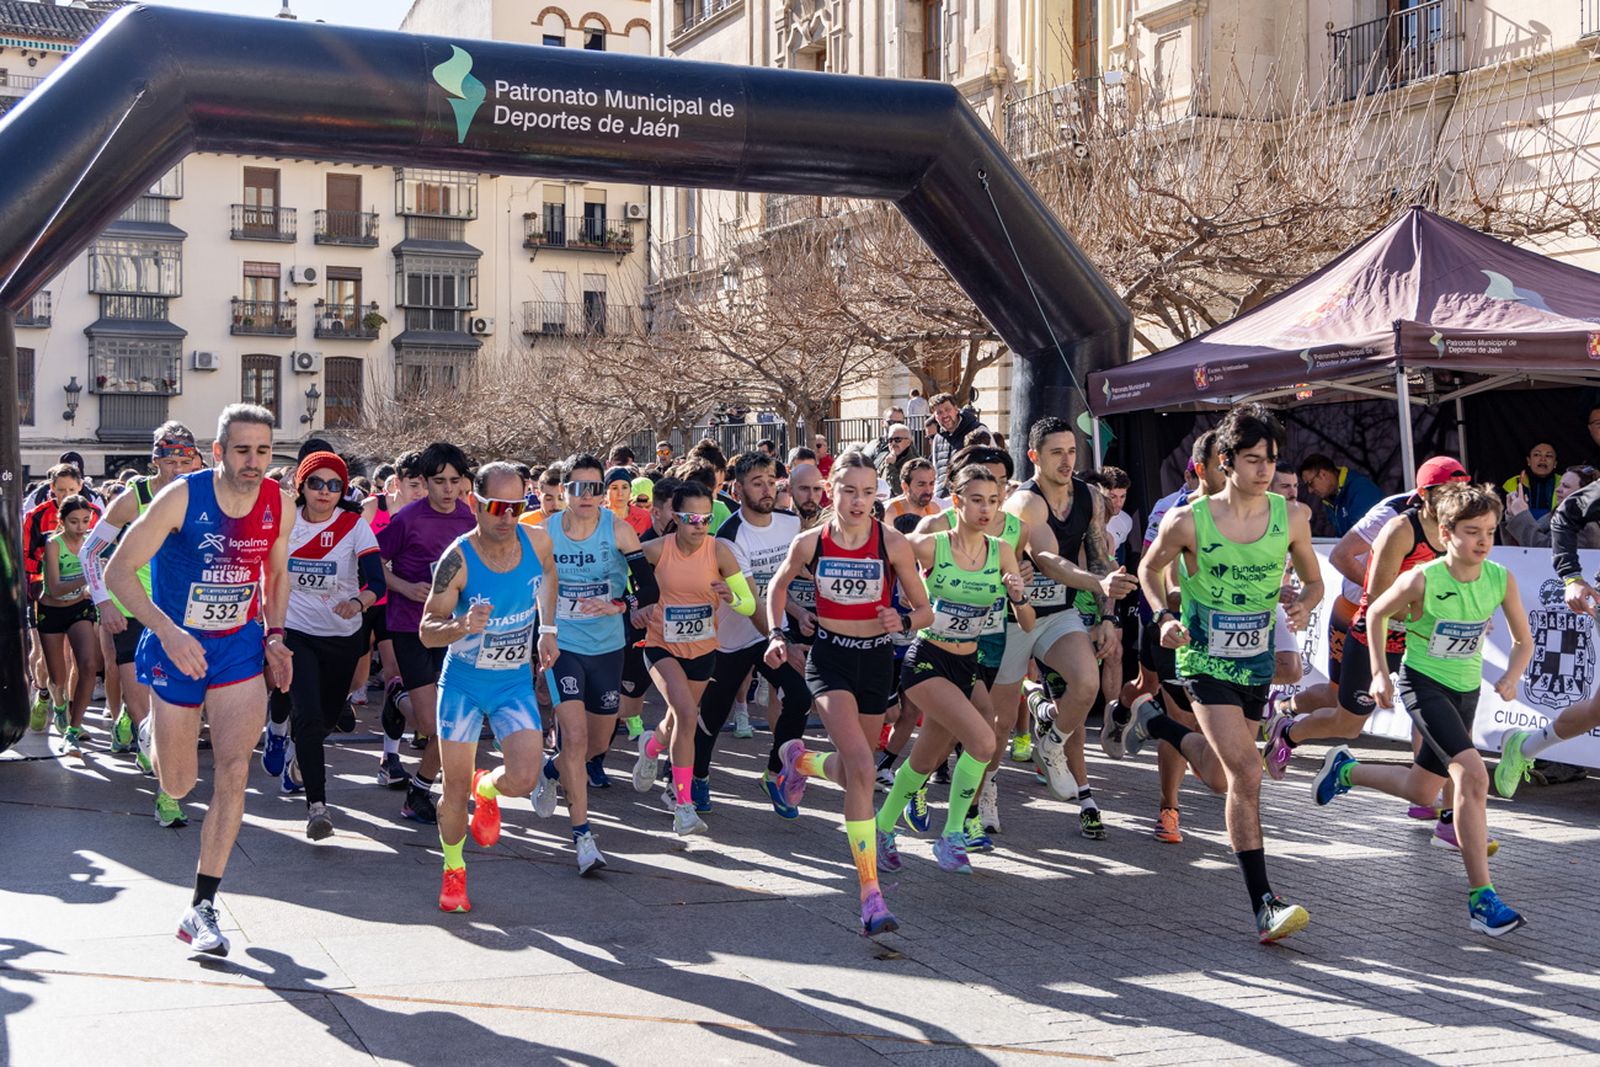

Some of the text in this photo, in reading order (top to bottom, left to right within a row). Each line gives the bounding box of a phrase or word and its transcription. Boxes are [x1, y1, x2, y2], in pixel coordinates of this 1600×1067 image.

[495, 80, 735, 118] Patronato Municipal de
[494, 105, 680, 138] Deportes de Jaén
[1446, 339, 1476, 348] Patronato
[1477, 340, 1508, 348] Municipal
[1314, 352, 1339, 361] Patronato
[1339, 350, 1366, 359] Municipal
[1448, 347, 1477, 355] Deportes
[2, 470, 13, 480] de
[229, 537, 268, 550] lapalma
[751, 557, 768, 567] BUENA
[1232, 561, 1278, 573] Fundación
[202, 569, 251, 583] DELSUR
[825, 568, 864, 577] BUENA MUERTE
[1232, 572, 1266, 582] Unicaja
[298, 574, 326, 587] 697
[831, 578, 867, 595] 499
[1031, 586, 1056, 599] 455
[203, 603, 239, 620] 532
[676, 619, 704, 634] 220
[948, 617, 970, 631] 28
[1218, 621, 1257, 629] BUENA MUERTE
[832, 635, 873, 649] NIKE
[1224, 630, 1260, 647] 708
[1446, 637, 1479, 652] 778
[494, 645, 526, 660] 762
[1494, 710, 1549, 730] CIUDAD
